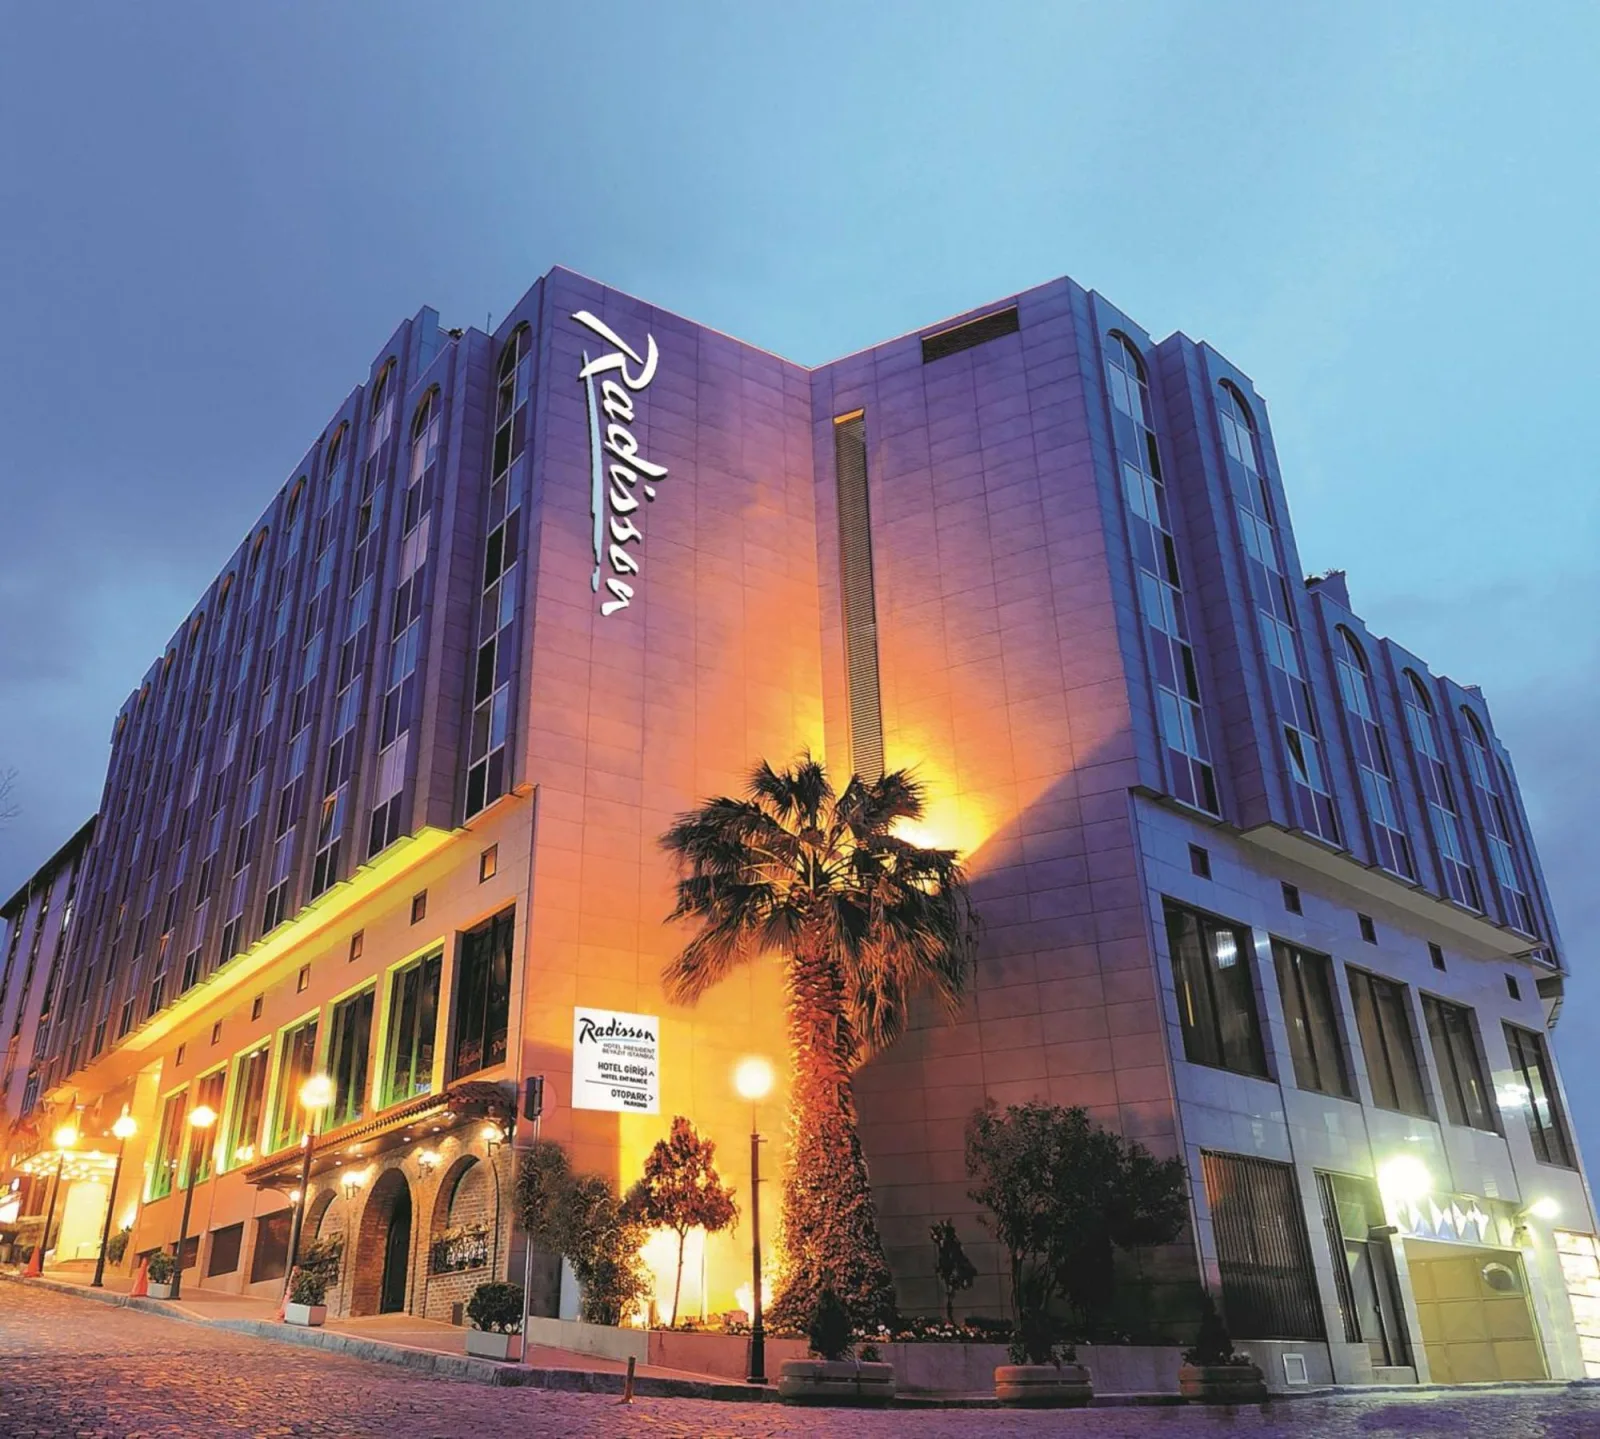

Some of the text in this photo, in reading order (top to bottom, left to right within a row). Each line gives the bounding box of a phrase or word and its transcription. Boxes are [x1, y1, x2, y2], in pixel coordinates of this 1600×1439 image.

[572, 310, 668, 616] Radisson
[579, 1017, 655, 1044] Radisson
[623, 1045, 655, 1053] PRESIDENT
[598, 1062, 622, 1072] HOTEL
[619, 1076, 647, 1085] ENTRANCE
[611, 1089, 647, 1108] OTOPARK PARKING
